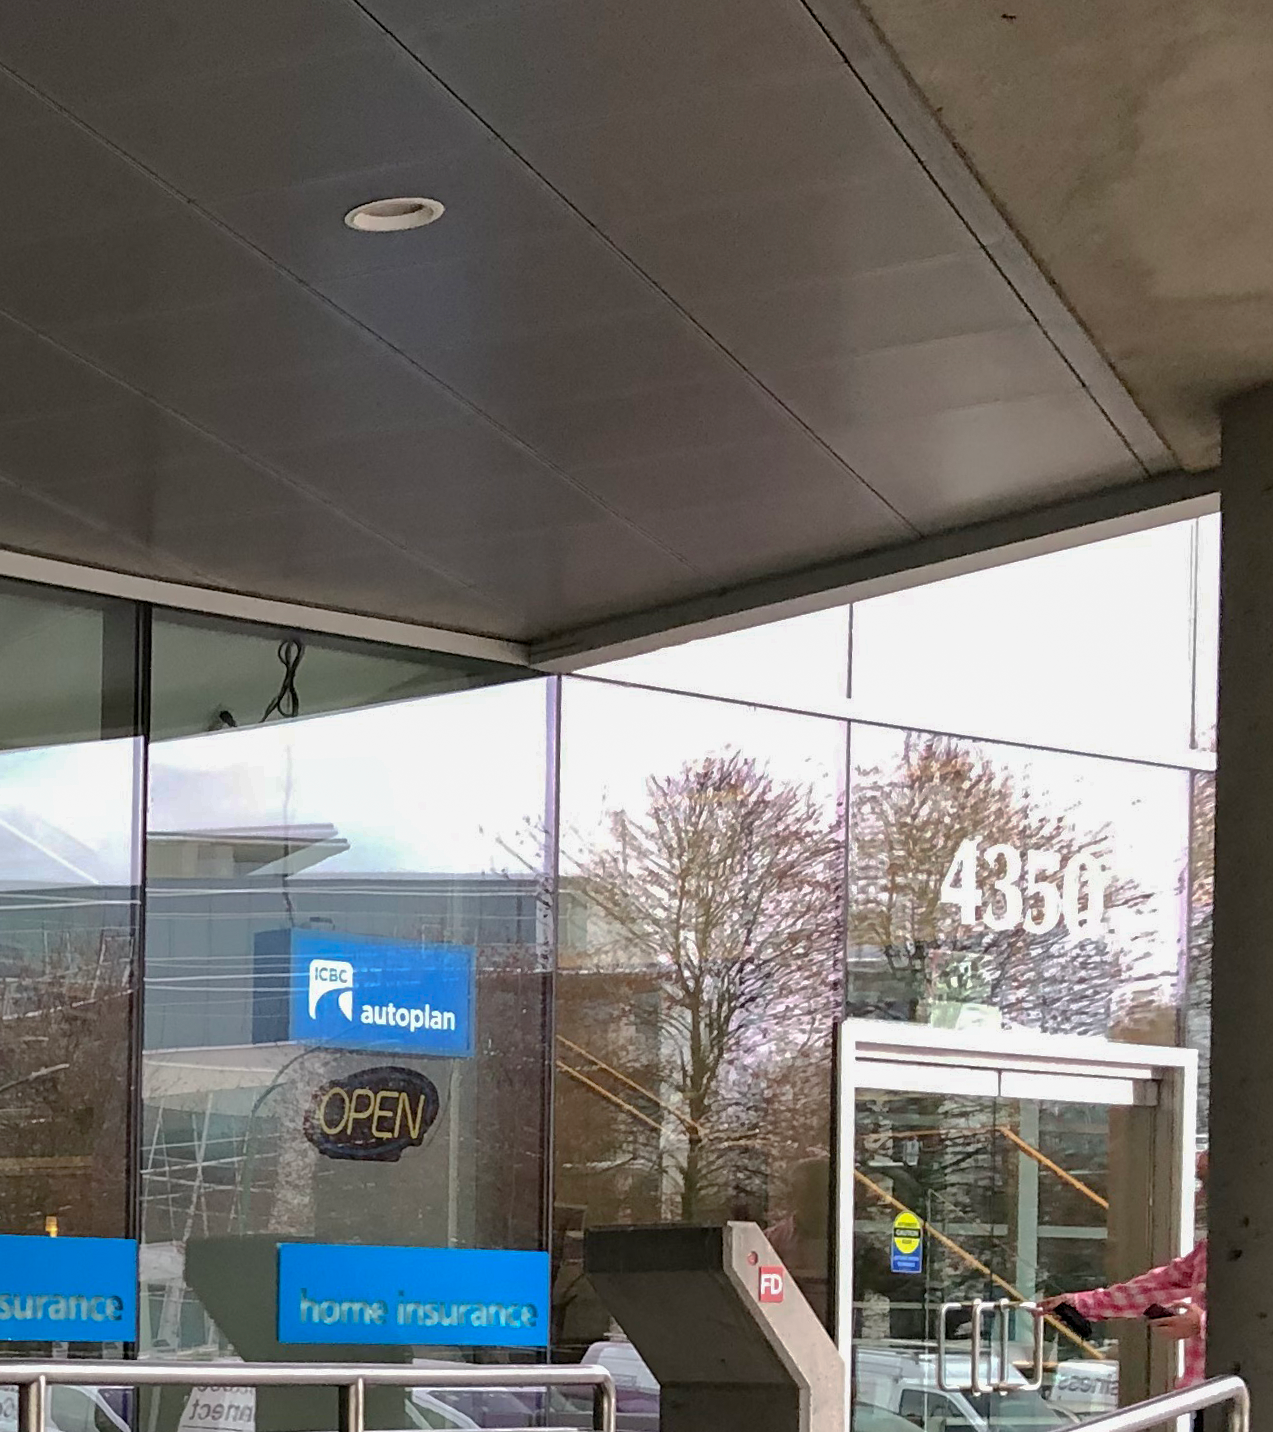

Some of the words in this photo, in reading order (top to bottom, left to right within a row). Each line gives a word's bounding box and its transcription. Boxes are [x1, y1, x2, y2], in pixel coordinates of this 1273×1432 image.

[940, 837, 1109, 934] 4350
[314, 966, 348, 984] ICBC
[360, 1002, 456, 1033] autoplan
[318, 1086, 425, 1140] OPEN
[761, 1273, 783, 1295] FD
[298, 1289, 387, 1326] home
[396, 1291, 539, 1329] insurance
